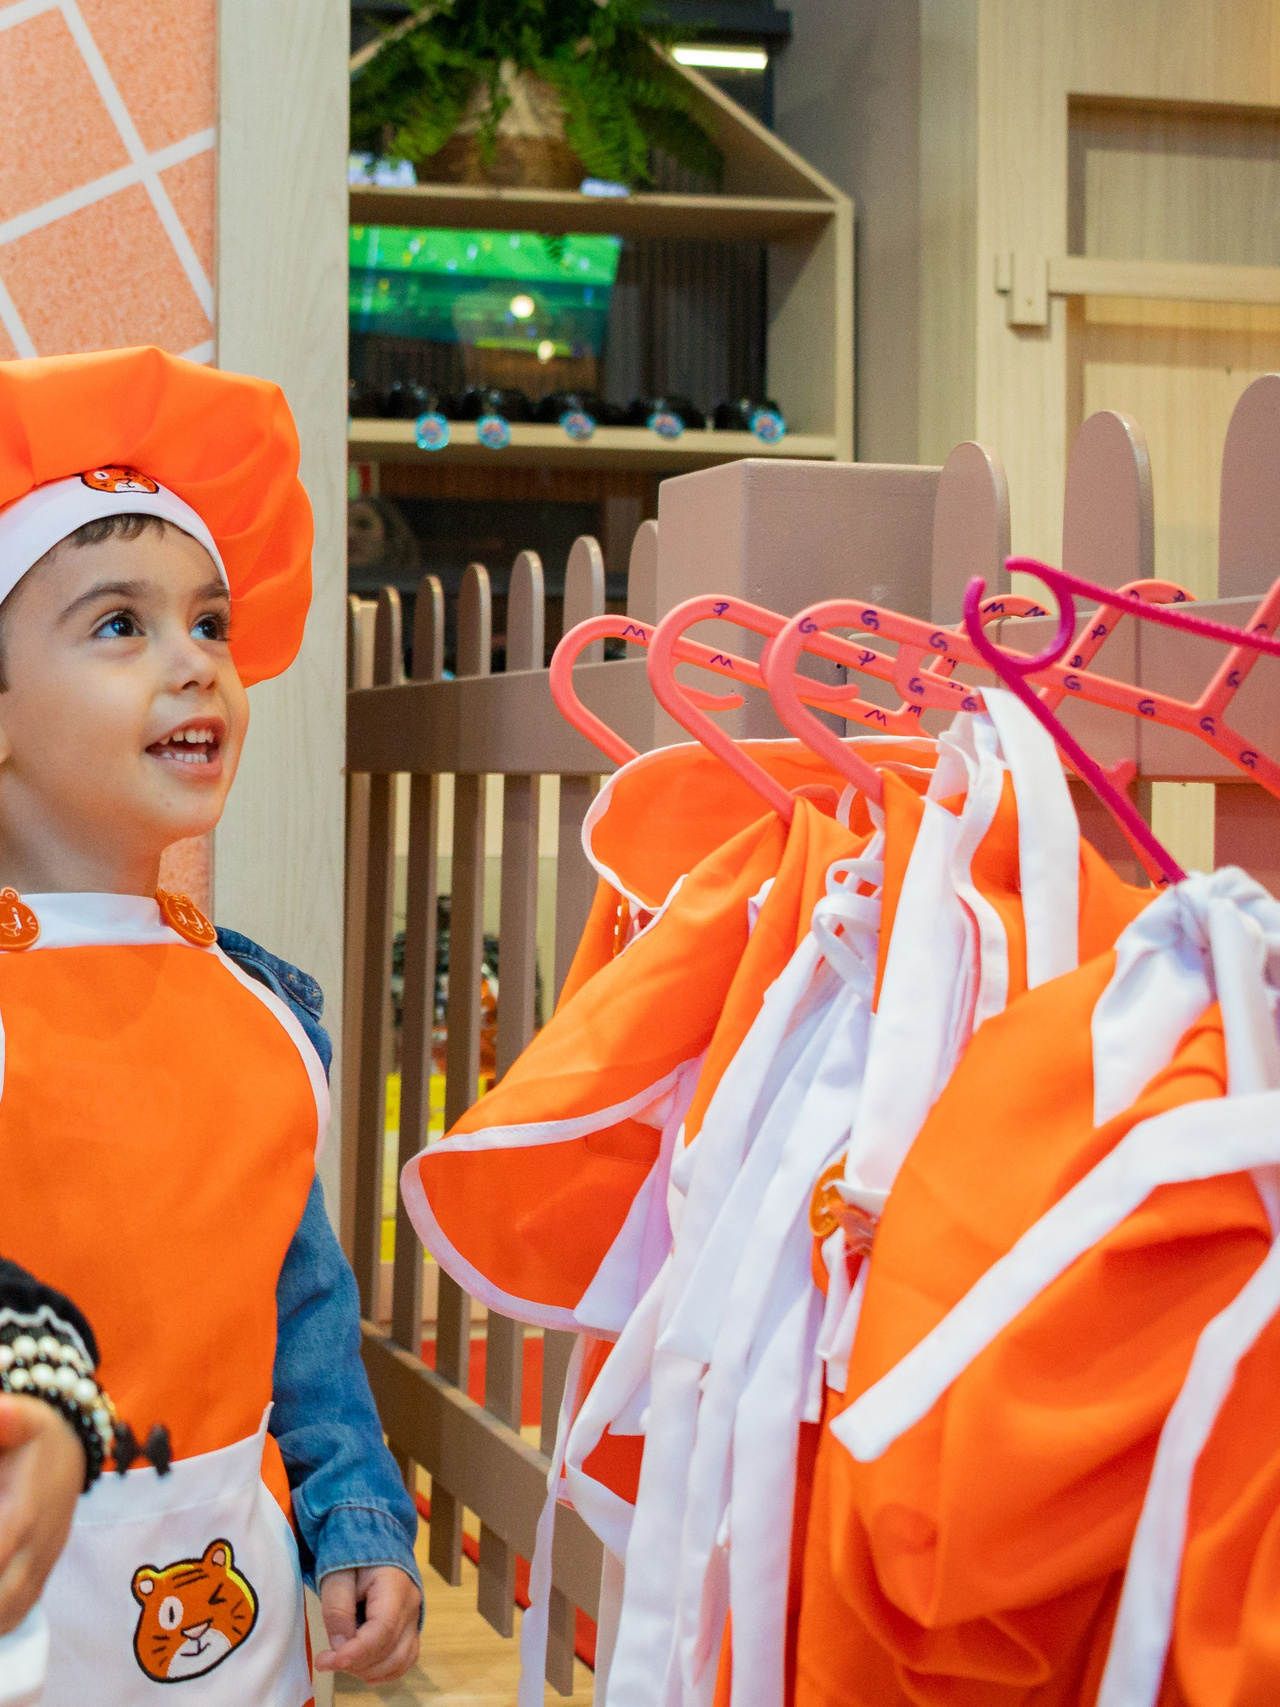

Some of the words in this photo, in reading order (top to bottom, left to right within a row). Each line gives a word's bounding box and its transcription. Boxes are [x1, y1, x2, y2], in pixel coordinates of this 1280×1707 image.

[983, 602, 1005, 613] M
[798, 617, 818, 634] G
[860, 609, 880, 631] G
[622, 625, 646, 641] M
[928, 632, 948, 651] G
[710, 654, 734, 670] M
[908, 677, 925, 695] G
[1064, 675, 1081, 691] G
[961, 696, 978, 711] G
[1138, 699, 1155, 716] G
[865, 709, 887, 726] M
[1199, 717, 1215, 736] G
[1239, 750, 1259, 770] G
